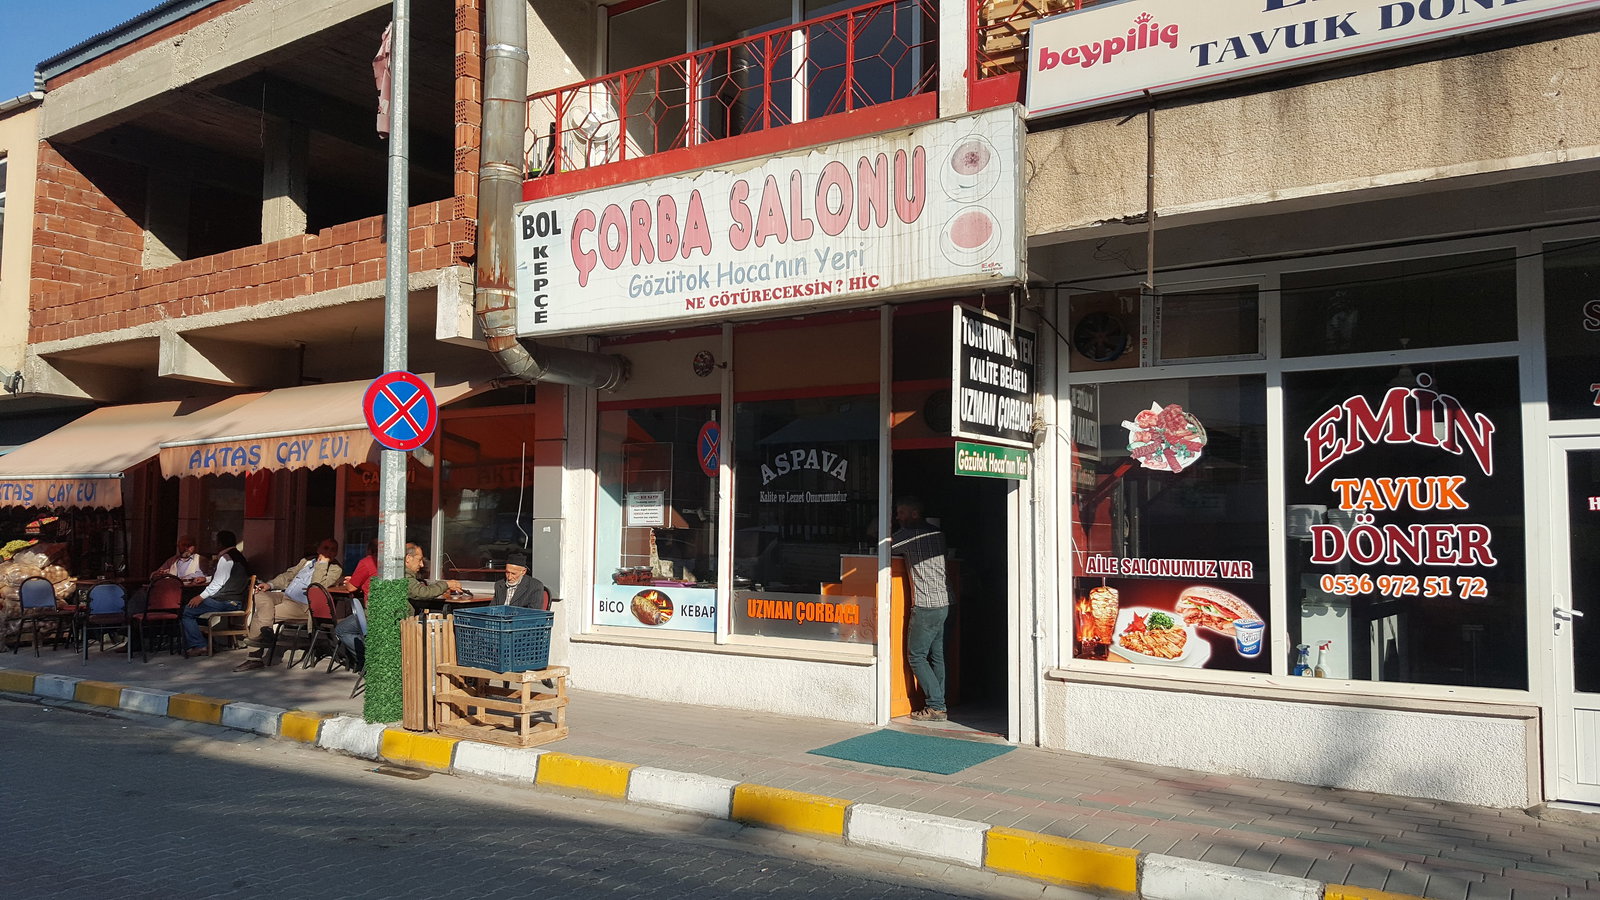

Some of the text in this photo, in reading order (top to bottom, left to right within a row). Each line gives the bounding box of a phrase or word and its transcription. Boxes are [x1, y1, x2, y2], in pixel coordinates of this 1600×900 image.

[1190, 11, 1360, 68] TAVUK
[522, 210, 561, 240] BOL
[570, 145, 926, 287] ÇORBA SALONU
[532, 245, 549, 324] KEPÇE
[629, 241, 864, 298] Gözütok Hoca'nın Yeri
[685, 296, 705, 311] NE
[849, 272, 880, 291] HİÇ
[1018, 336, 1033, 365] TEK
[969, 356, 1028, 394] KALİTE BELGELİ
[961, 387, 997, 426] UZMAN
[997, 395, 1033, 434] ÇORBACI
[1304, 372, 1495, 484] EMİN
[189, 444, 261, 471] AKTAŞ
[276, 440, 314, 467] ÇAY
[760, 449, 849, 486] ASPAVA
[958, 449, 1027, 477] Gözütok Hoca'nın Yeri
[0, 483, 34, 506] TAŞ
[47, 484, 74, 505] ÇAY
[760, 491, 777, 503] Kalite
[778, 493, 786, 503] ve
[786, 491, 804, 503] Lezzet
[1332, 475, 1469, 511] TAVUK
[1310, 514, 1497, 566] DÖNER
[1086, 554, 1253, 579] AİLE SALONUMUZ VAR
[1320, 573, 1488, 599] 0536 972 51 72
[599, 597, 716, 618] BİCO KEBAP
[747, 598, 860, 625] UZMAN ÇORBACI
